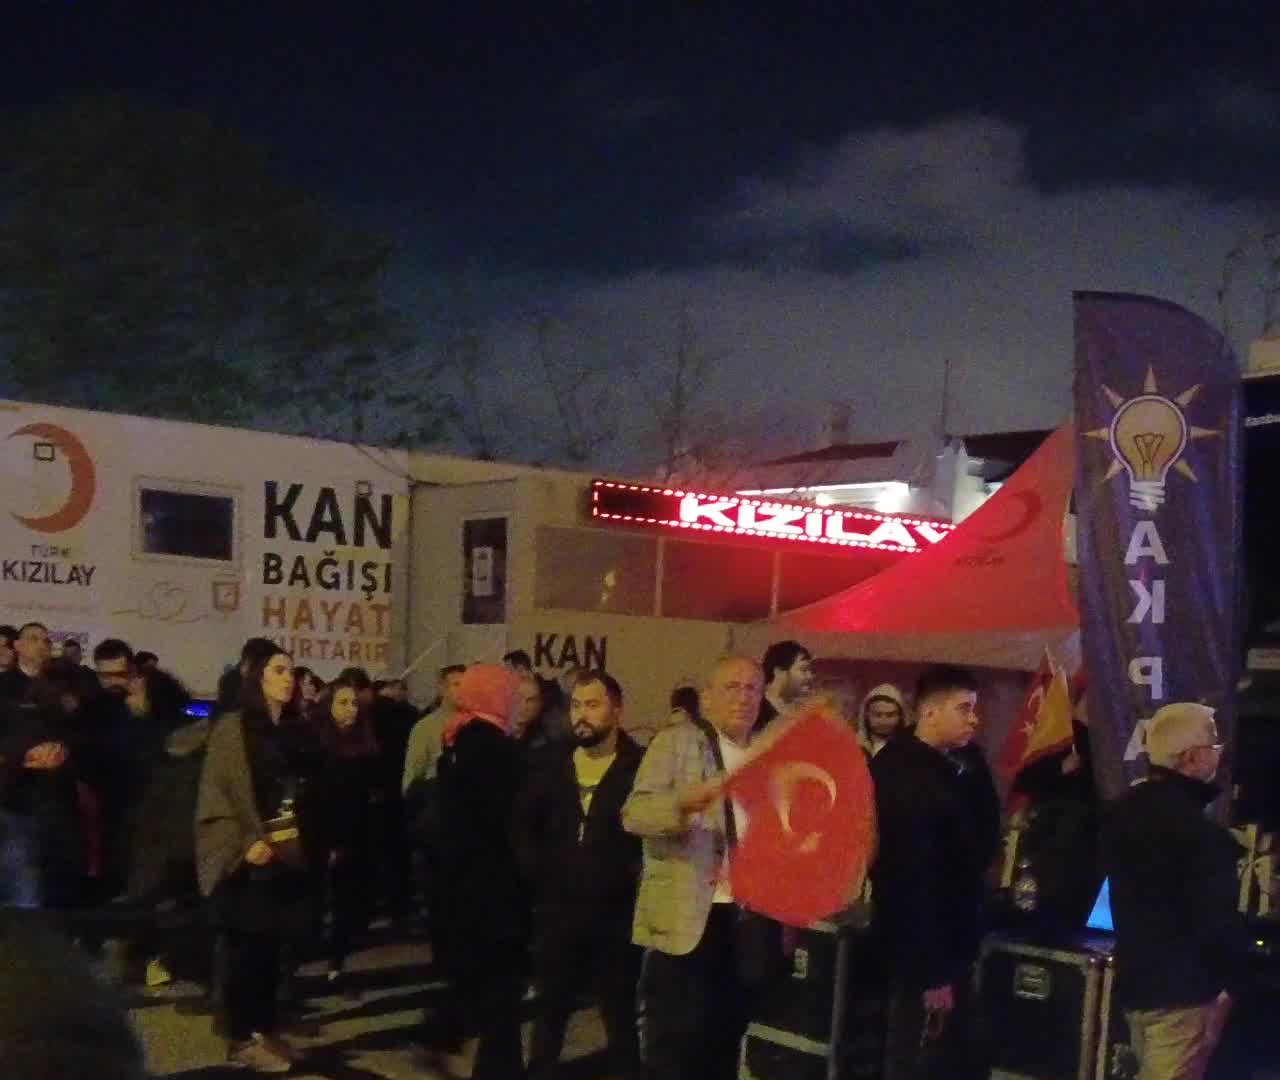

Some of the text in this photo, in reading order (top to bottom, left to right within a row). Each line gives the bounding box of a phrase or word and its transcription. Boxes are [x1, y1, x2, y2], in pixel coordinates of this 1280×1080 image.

[263, 480, 393, 550] KAN
[2, 560, 96, 586] KIZILAY
[263, 550, 393, 601] BAĞIŞI
[262, 596, 393, 639] HAYAT
[279, 635, 392, 663] URTARIR
[534, 631, 608, 673] KAN
